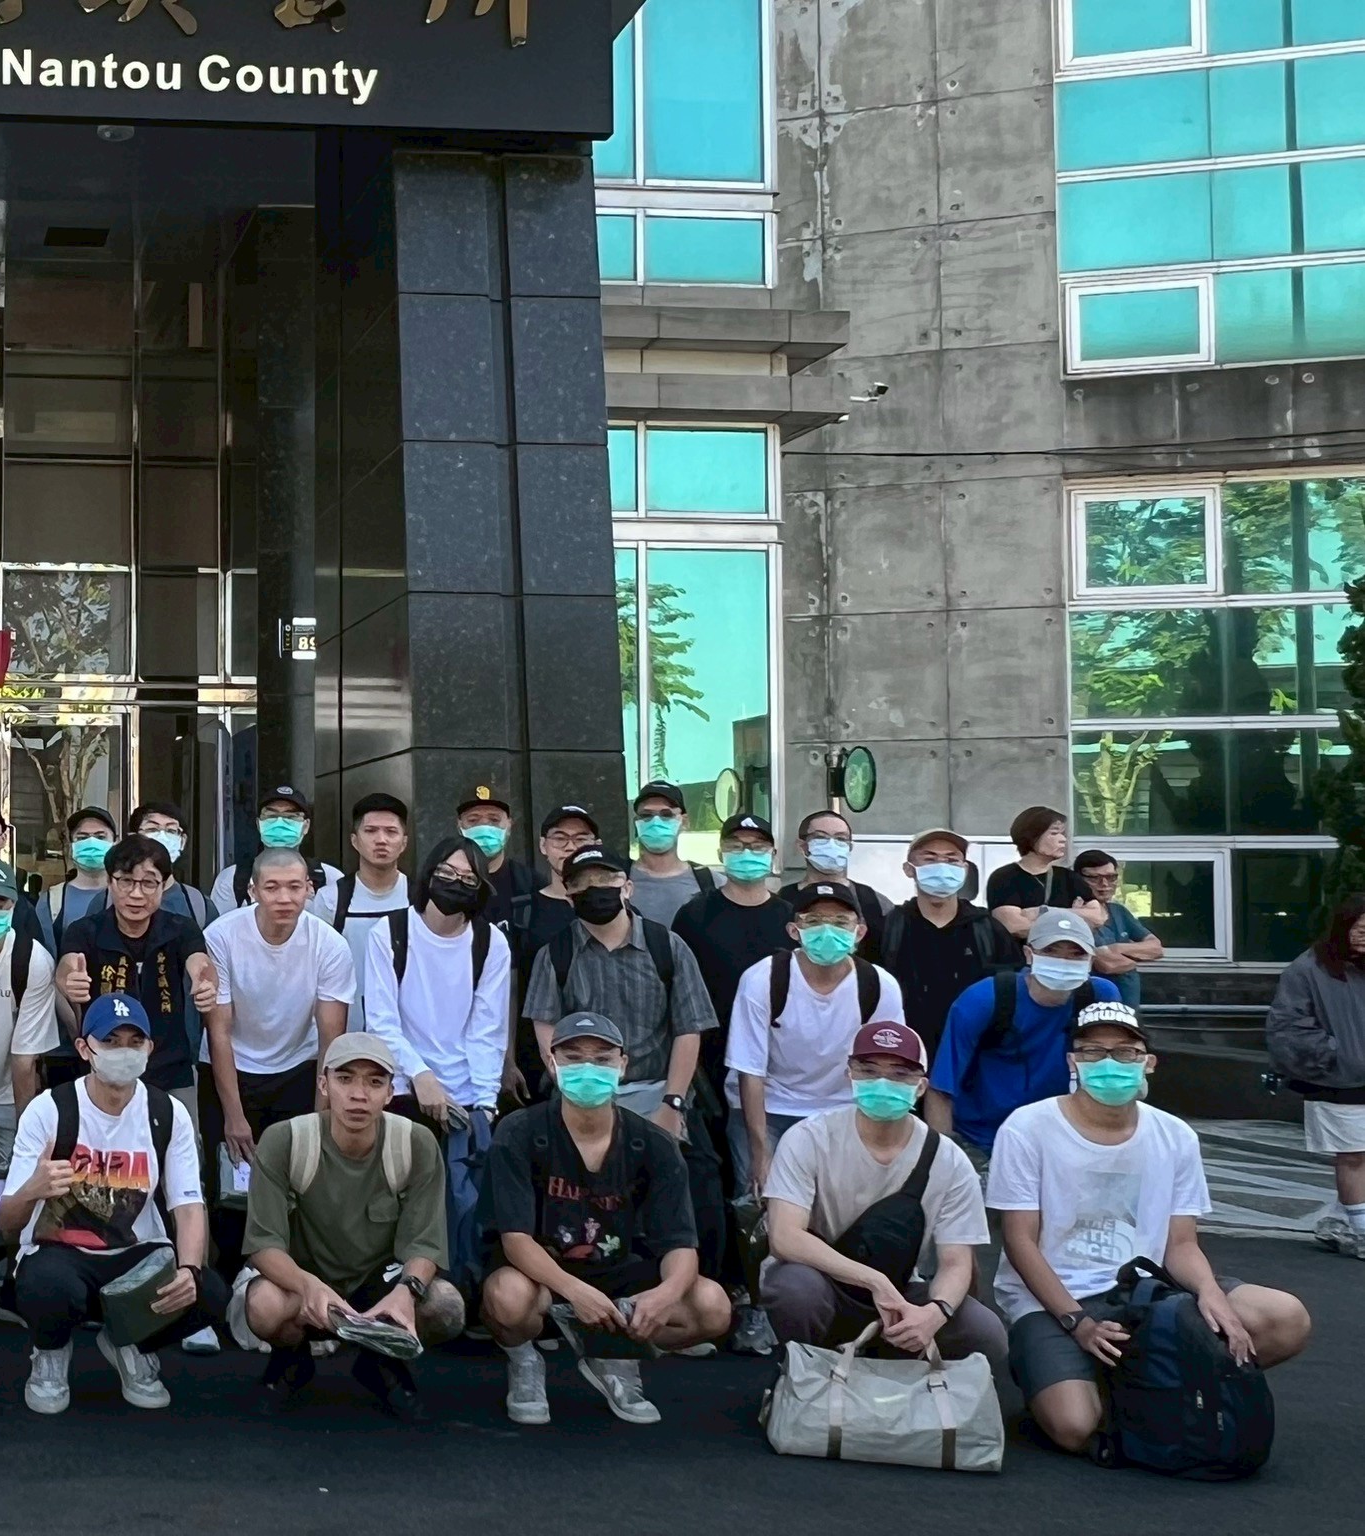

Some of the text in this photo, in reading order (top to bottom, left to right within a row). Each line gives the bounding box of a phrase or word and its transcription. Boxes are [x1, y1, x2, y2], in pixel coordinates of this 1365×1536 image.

[2, 48, 182, 91] Nantou
[198, 54, 378, 105] County
[112, 998, 131, 1017] LA
